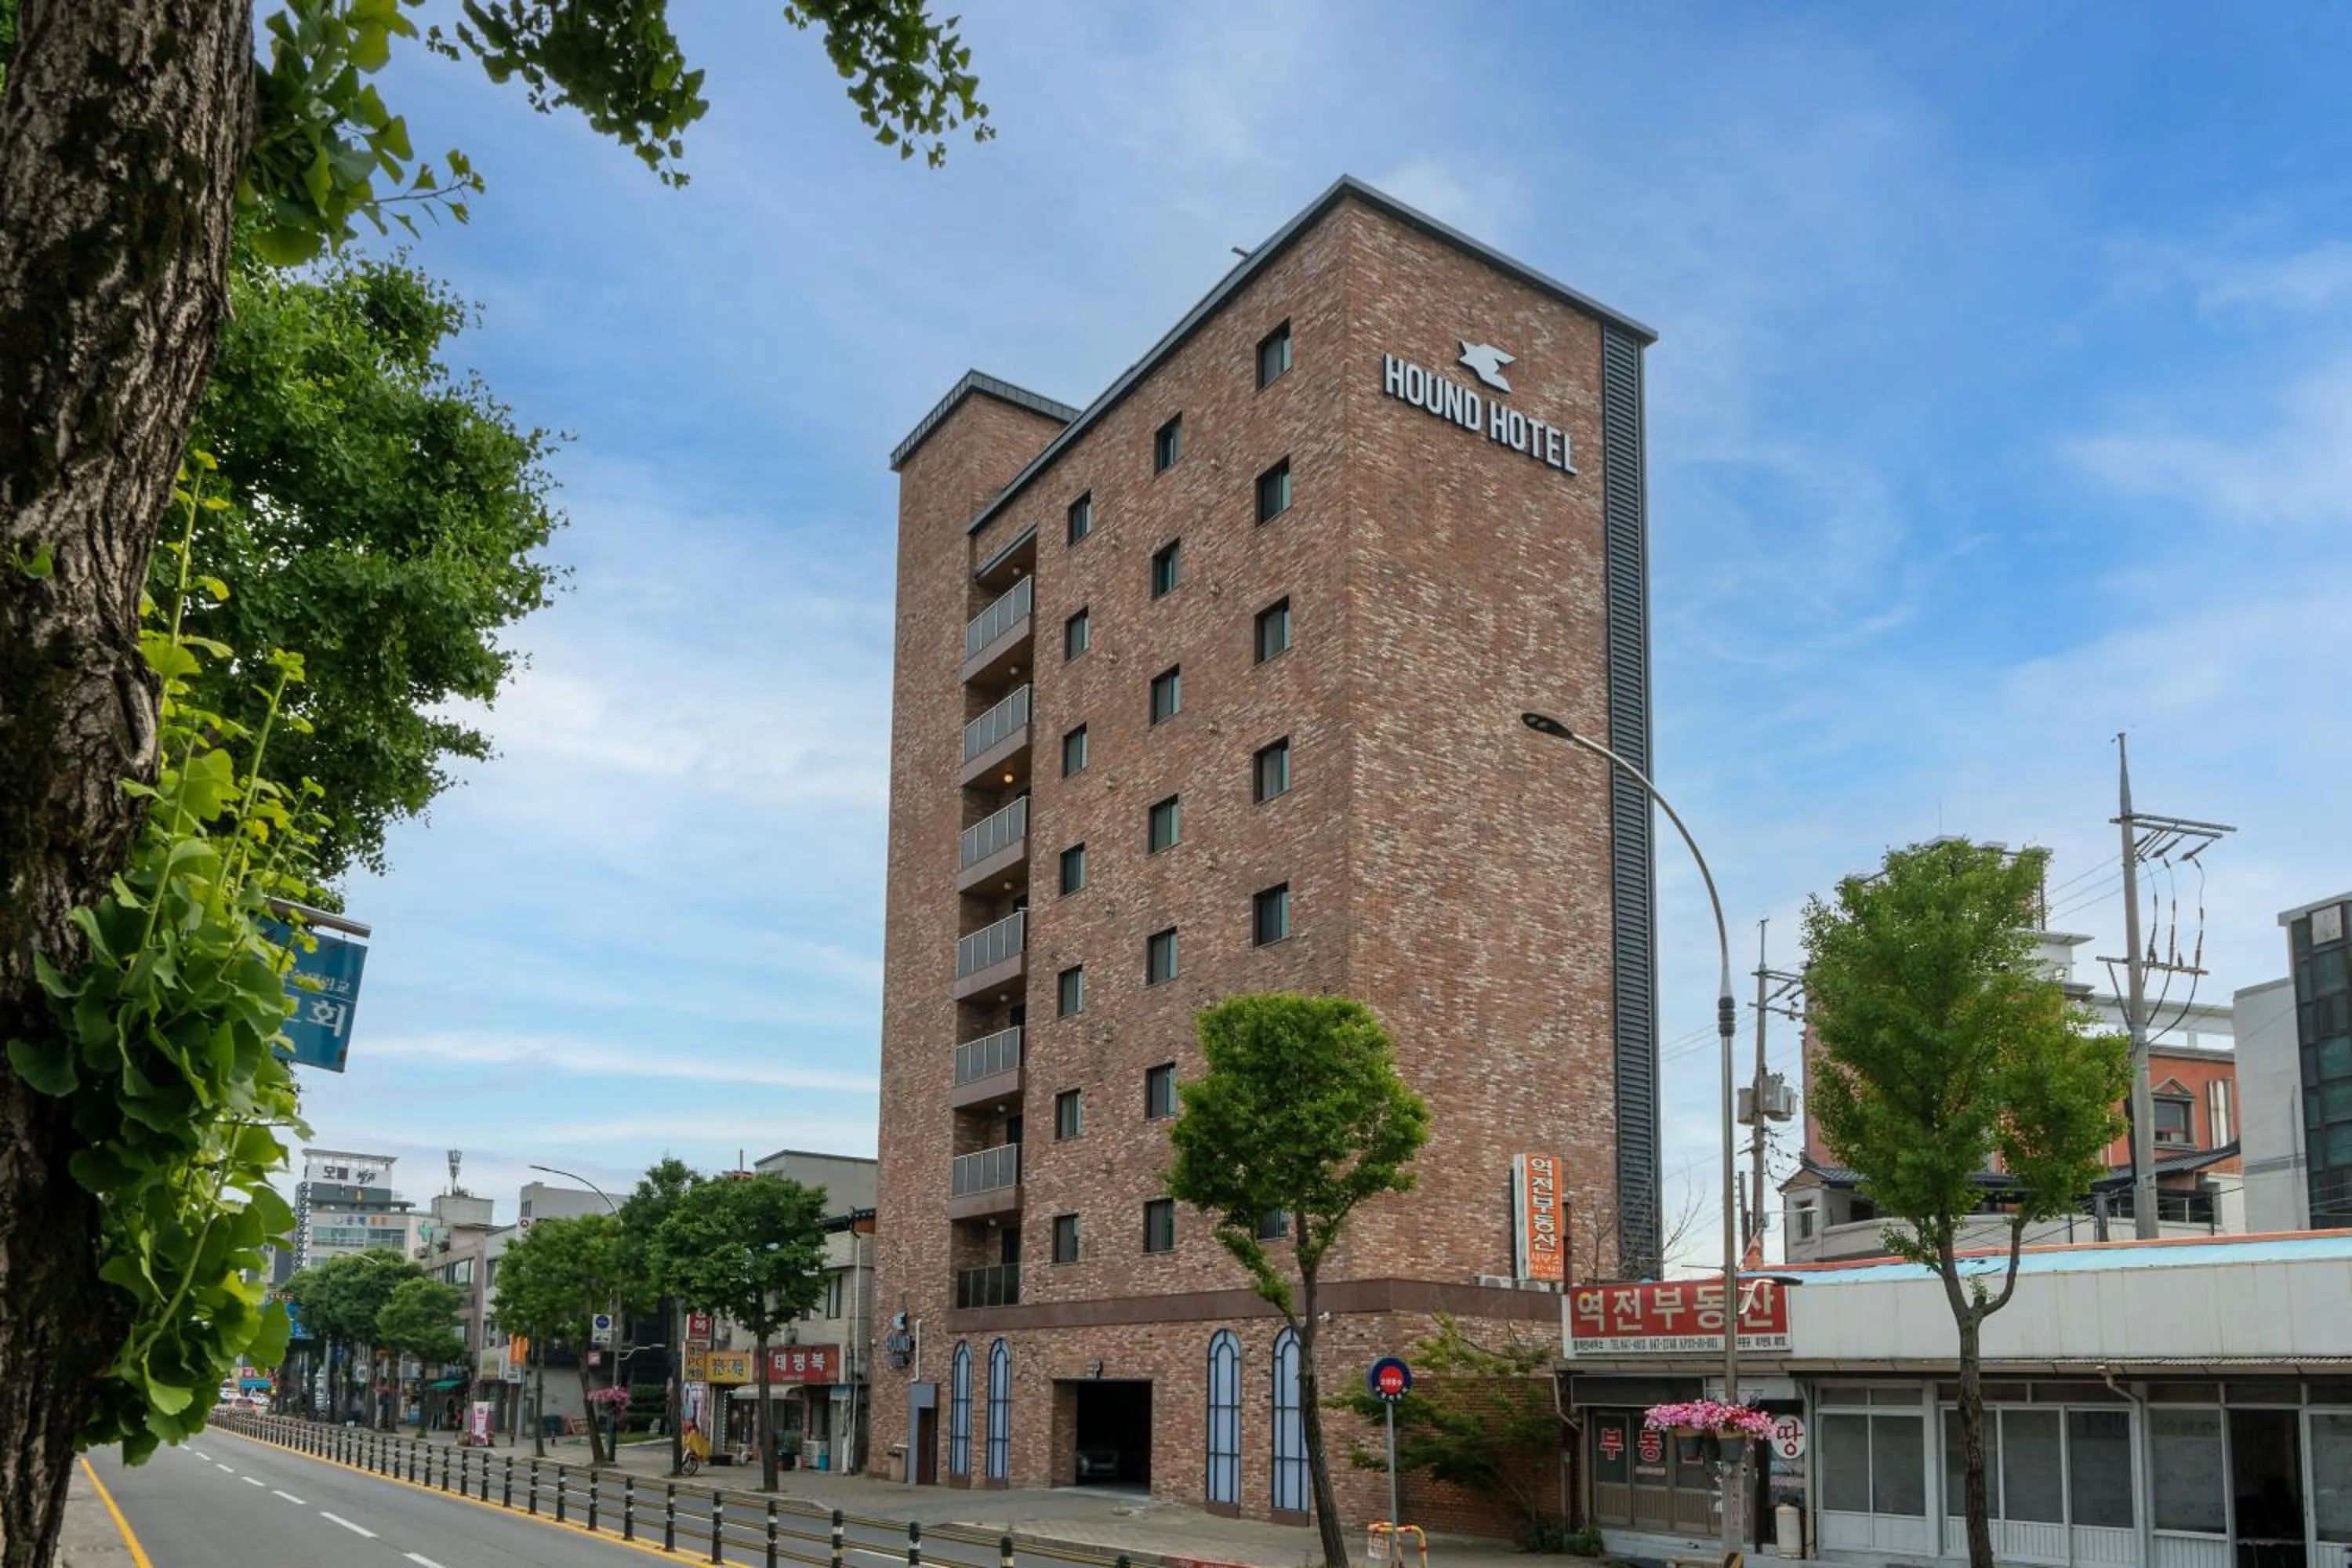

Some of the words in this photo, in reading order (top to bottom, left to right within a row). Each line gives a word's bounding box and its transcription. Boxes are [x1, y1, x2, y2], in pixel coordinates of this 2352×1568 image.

[1385, 354, 1481, 430] HOUND
[1490, 401, 1577, 475] HOTEL
[1530, 1157, 1558, 1253] 역전부동산
[1577, 1283, 1773, 1332] 역전부동산
[1777, 1420, 1804, 1456] 땅
